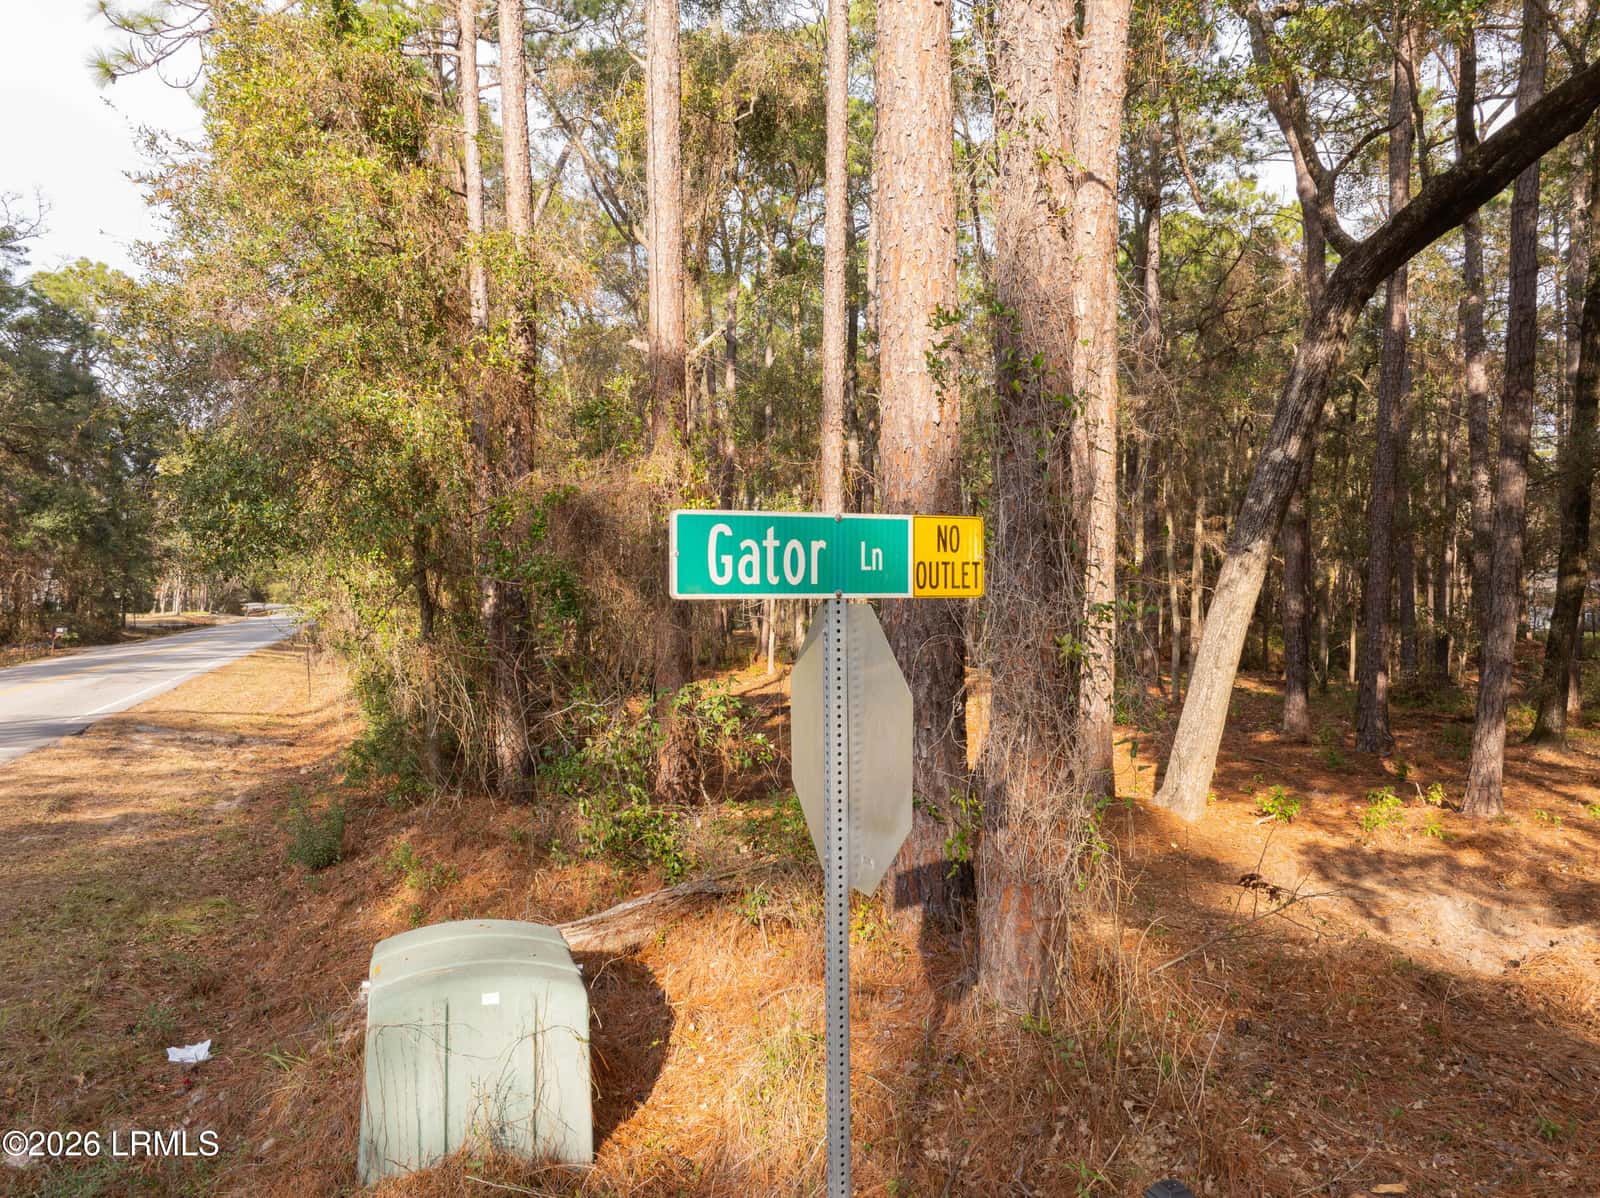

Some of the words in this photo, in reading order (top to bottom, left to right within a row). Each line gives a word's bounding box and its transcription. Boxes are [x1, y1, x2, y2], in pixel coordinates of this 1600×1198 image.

[936, 524, 960, 553] NO
[707, 523, 827, 586] Gator
[860, 541, 883, 572] Ln
[915, 560, 981, 590] OUTLET
